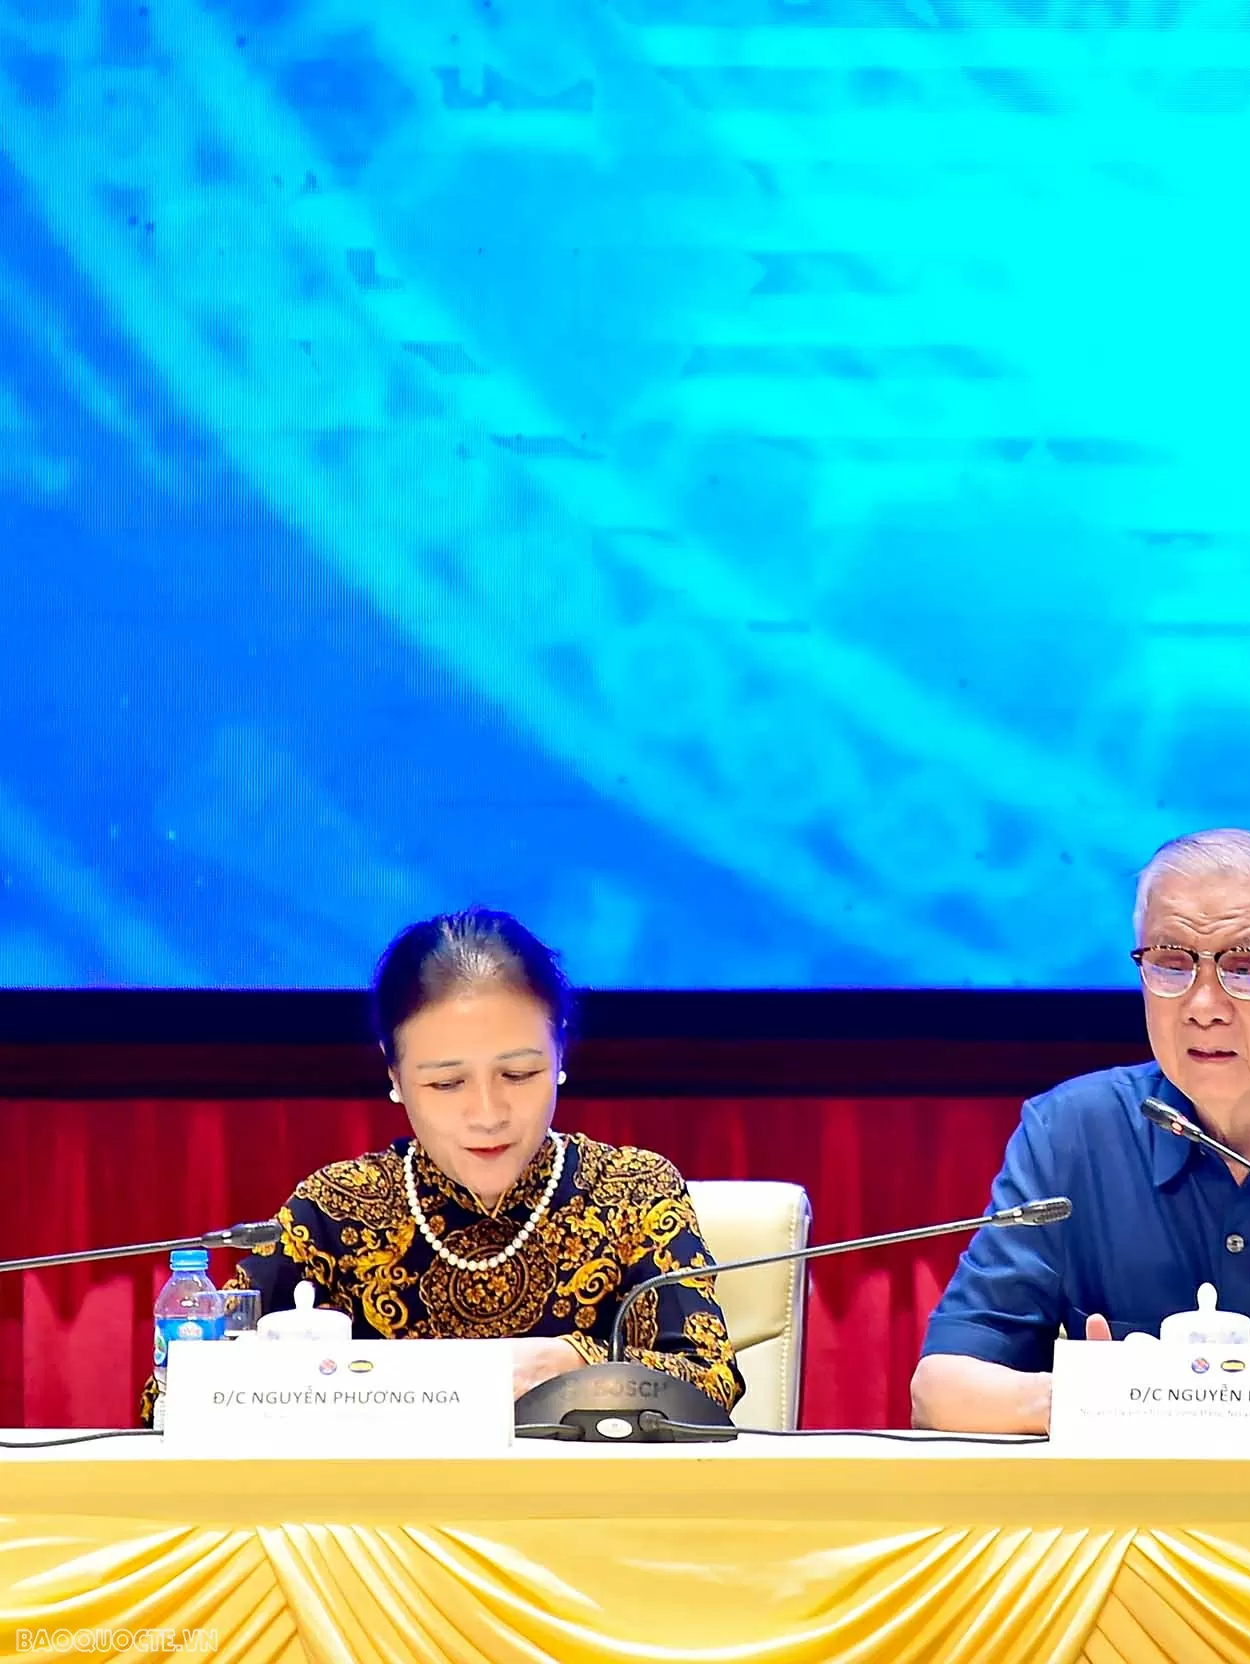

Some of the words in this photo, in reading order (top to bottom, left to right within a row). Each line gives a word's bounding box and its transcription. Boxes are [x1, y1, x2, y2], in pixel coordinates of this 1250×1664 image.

[213, 1391, 246, 1406] Đ/C
[252, 1385, 327, 1405] NGUYỄN
[333, 1390, 415, 1405] PHƯƠNG
[422, 1390, 460, 1404] NGA
[1129, 1387, 1162, 1403] Đ/C
[1168, 1384, 1242, 1403] NGUYỄN
